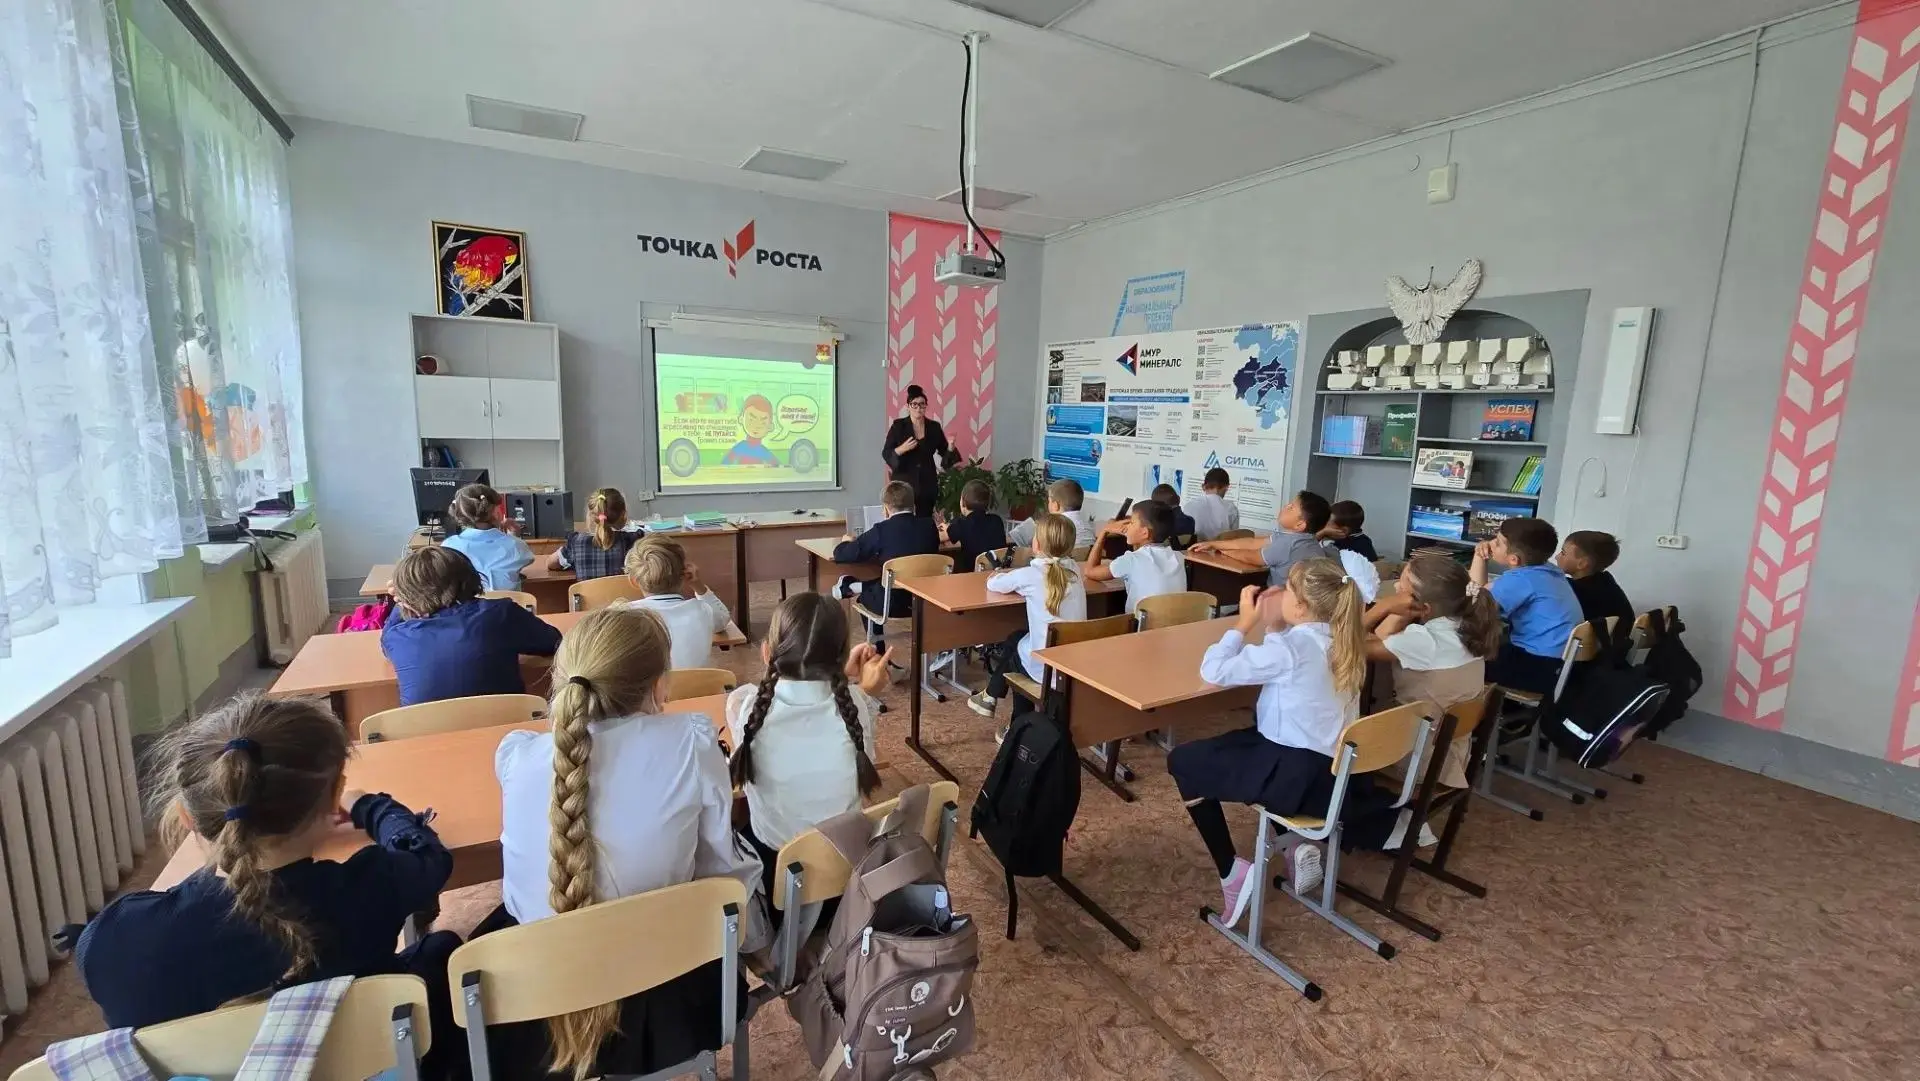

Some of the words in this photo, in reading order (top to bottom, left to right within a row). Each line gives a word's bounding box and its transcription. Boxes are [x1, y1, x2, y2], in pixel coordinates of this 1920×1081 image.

[637, 234, 718, 260] ТОЧКА
[756, 248, 822, 271] РОСТА
[1140, 348, 1162, 358] АМУР
[1139, 358, 1182, 369] МИНЕРАЛС
[1490, 404, 1532, 414] УСПЕХ
[1225, 455, 1265, 467] СИГМА
